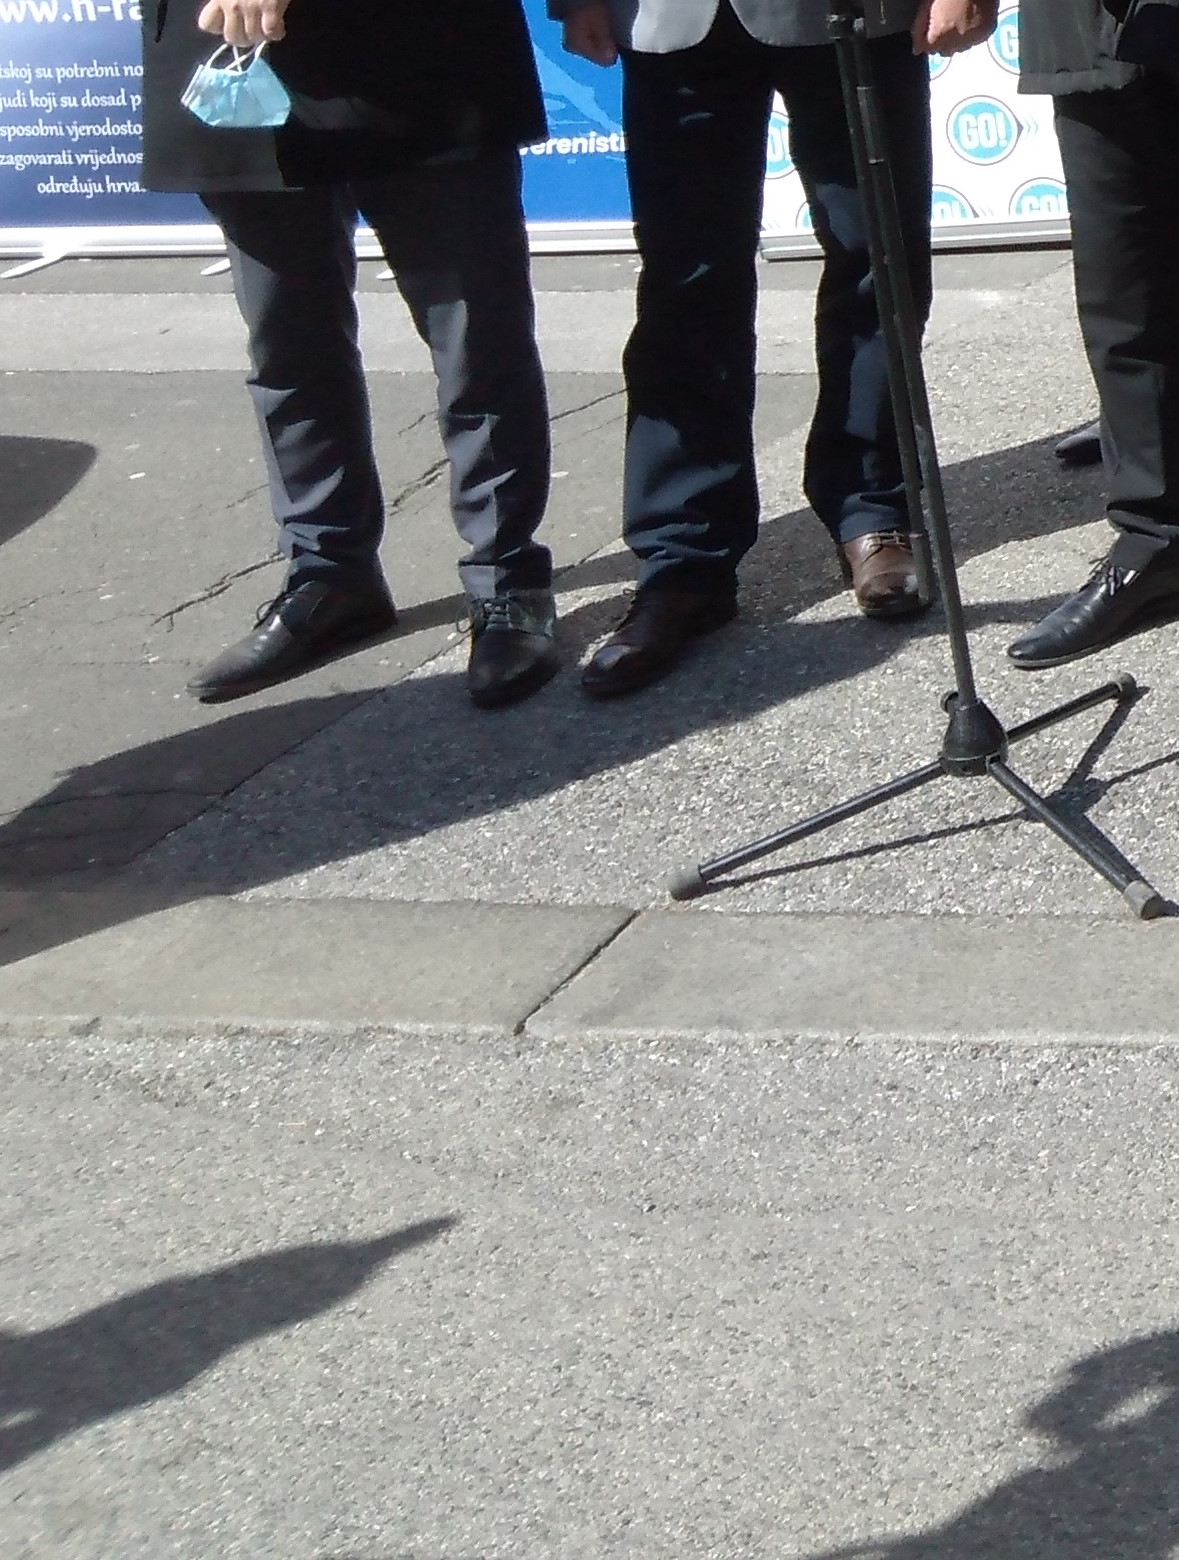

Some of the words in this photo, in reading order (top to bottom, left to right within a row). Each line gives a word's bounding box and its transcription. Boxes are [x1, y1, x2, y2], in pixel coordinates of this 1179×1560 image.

[35, 67, 53, 78] su
[56, 60, 121, 83] potrebni
[30, 89, 58, 113] koji
[60, 96, 79, 108] su
[81, 88, 127, 107] dosad
[0, 118, 65, 142] sposobni
[66, 117, 143, 142] vjerodosto
[958, 110, 1008, 150] GO!
[0, 149, 73, 171] zagovarati
[37, 175, 105, 199] određuju
[105, 174, 147, 193] hrva
